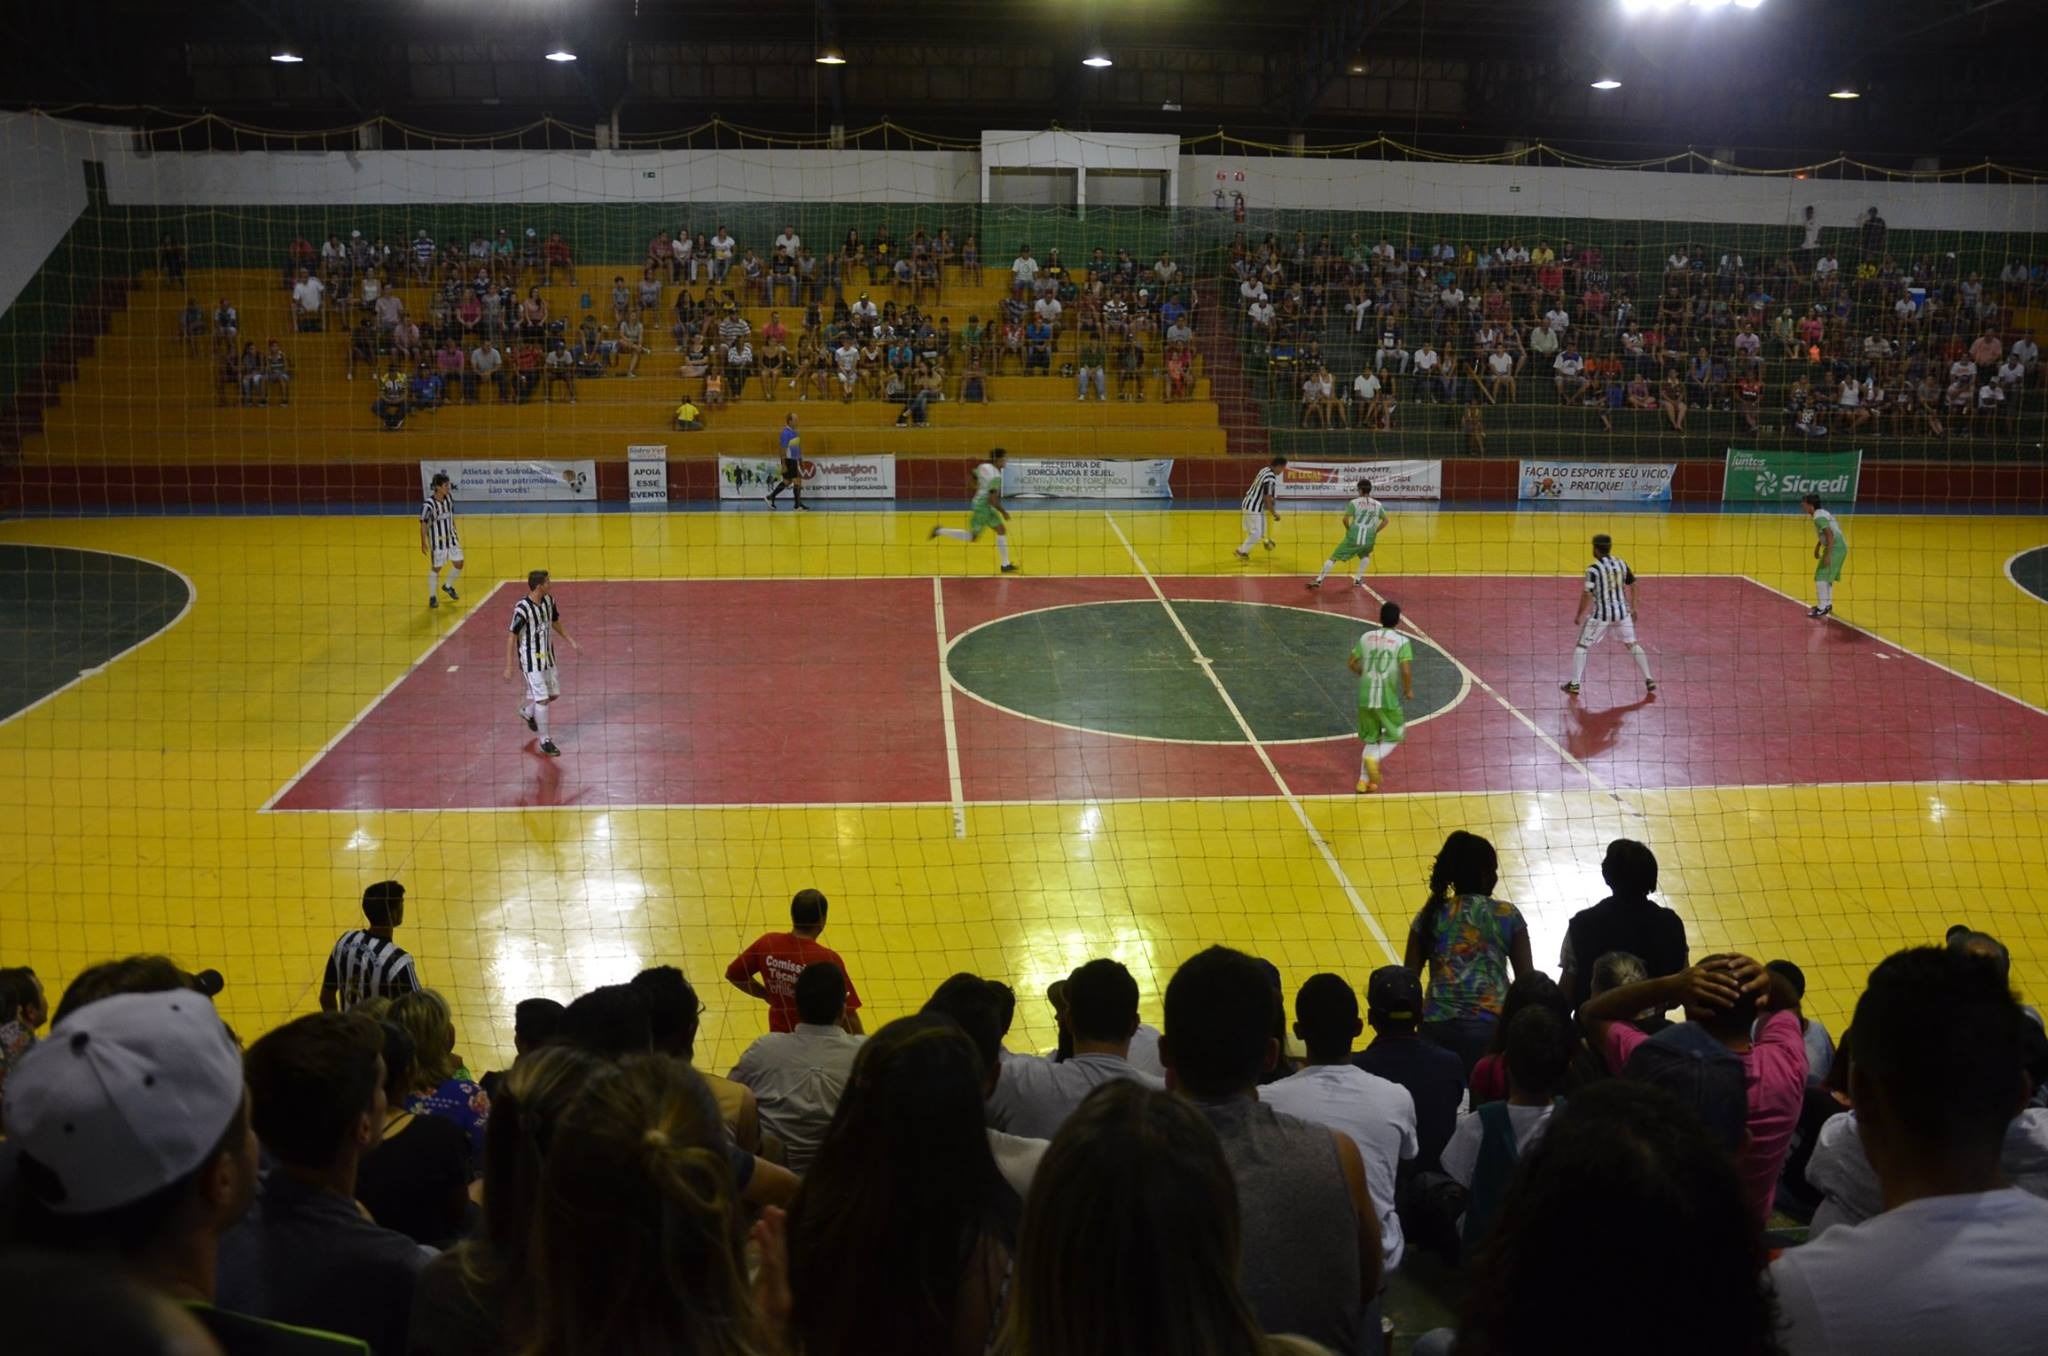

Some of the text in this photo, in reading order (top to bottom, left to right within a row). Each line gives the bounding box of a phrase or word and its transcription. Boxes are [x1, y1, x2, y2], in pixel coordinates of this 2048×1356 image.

[1525, 466, 1551, 477] FAÇA
[1552, 466, 1568, 477] DO
[1571, 467, 1615, 477] ESPORTE
[1618, 468, 1639, 478] SEU
[637, 480, 660, 488] ESSE
[1401, 484, 1434, 492] PRATICA!
[1570, 480, 1625, 492] PRATIQUE!
[1781, 474, 1850, 493] Sicredi
[630, 491, 666, 499] EVENTO
[1367, 649, 1393, 673] 10
